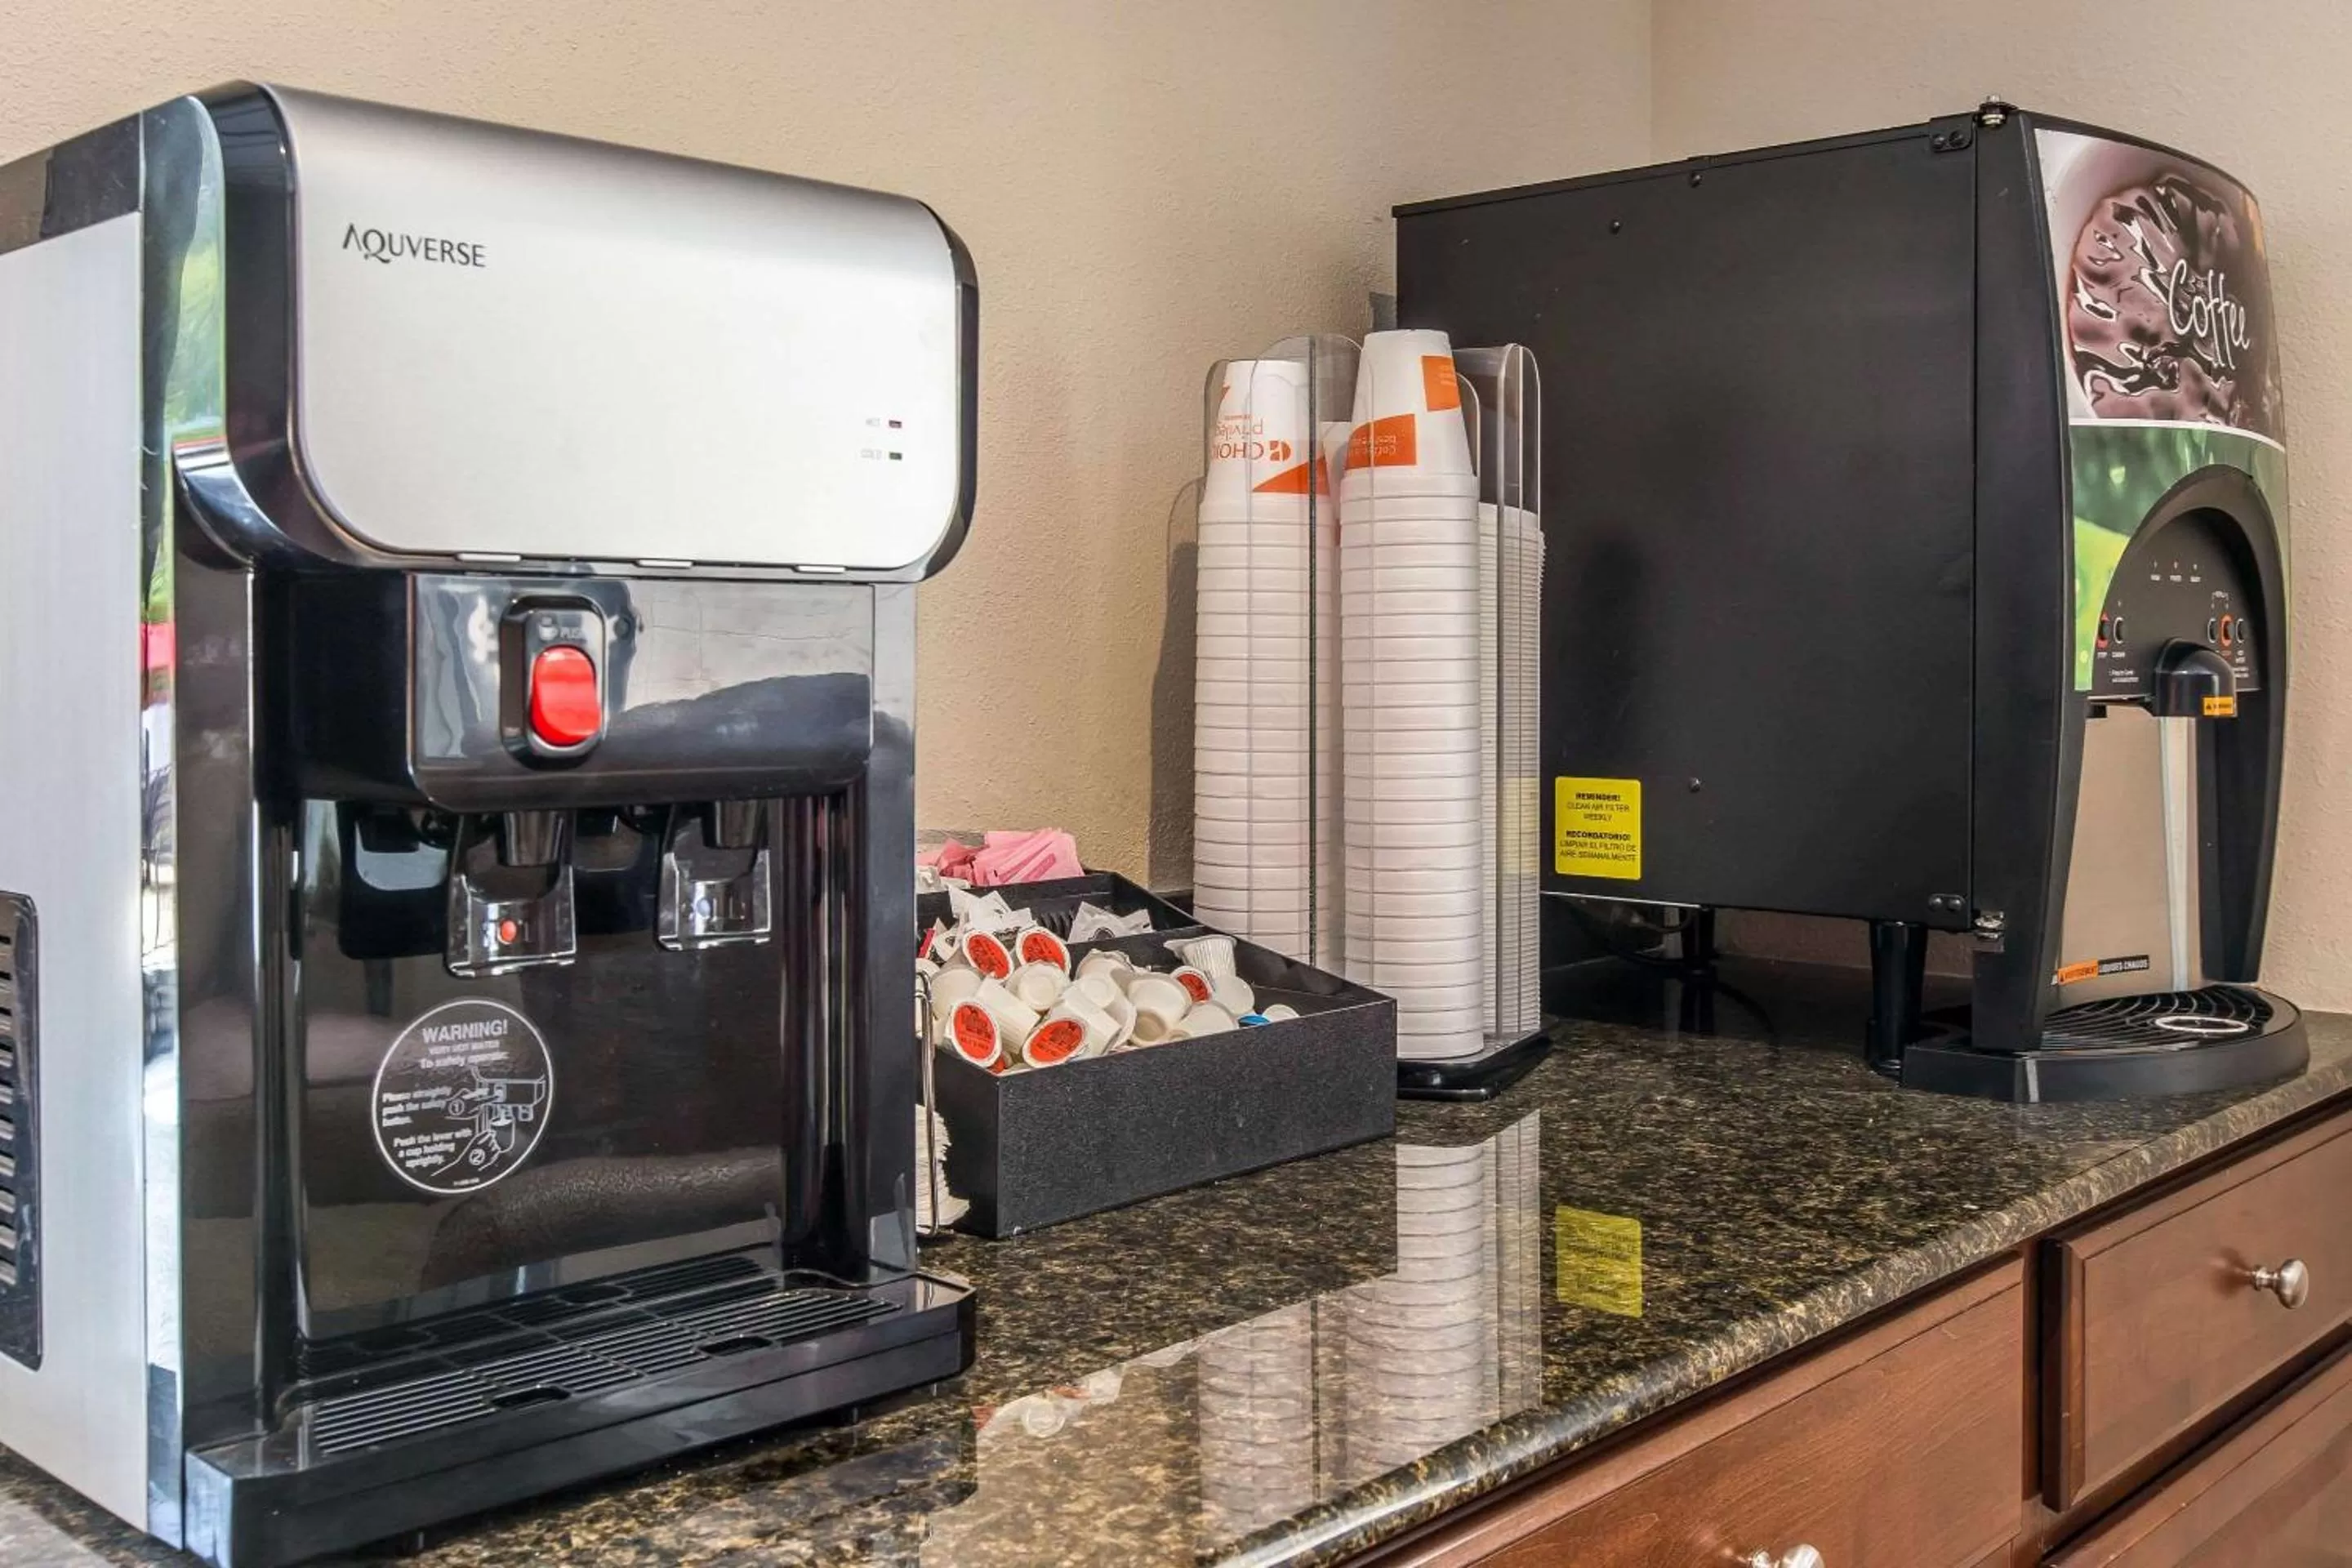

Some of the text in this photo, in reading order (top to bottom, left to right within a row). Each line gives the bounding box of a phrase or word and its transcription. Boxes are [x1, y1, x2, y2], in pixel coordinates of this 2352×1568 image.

[342, 223, 487, 268] AQUVERSE
[2168, 259, 2251, 370] Coffee
[1212, 442, 1264, 460] CHOI
[1566, 802, 1590, 810] CLEAN
[1606, 804, 1630, 813] FILTER
[423, 1019, 508, 1044] WARNING!
